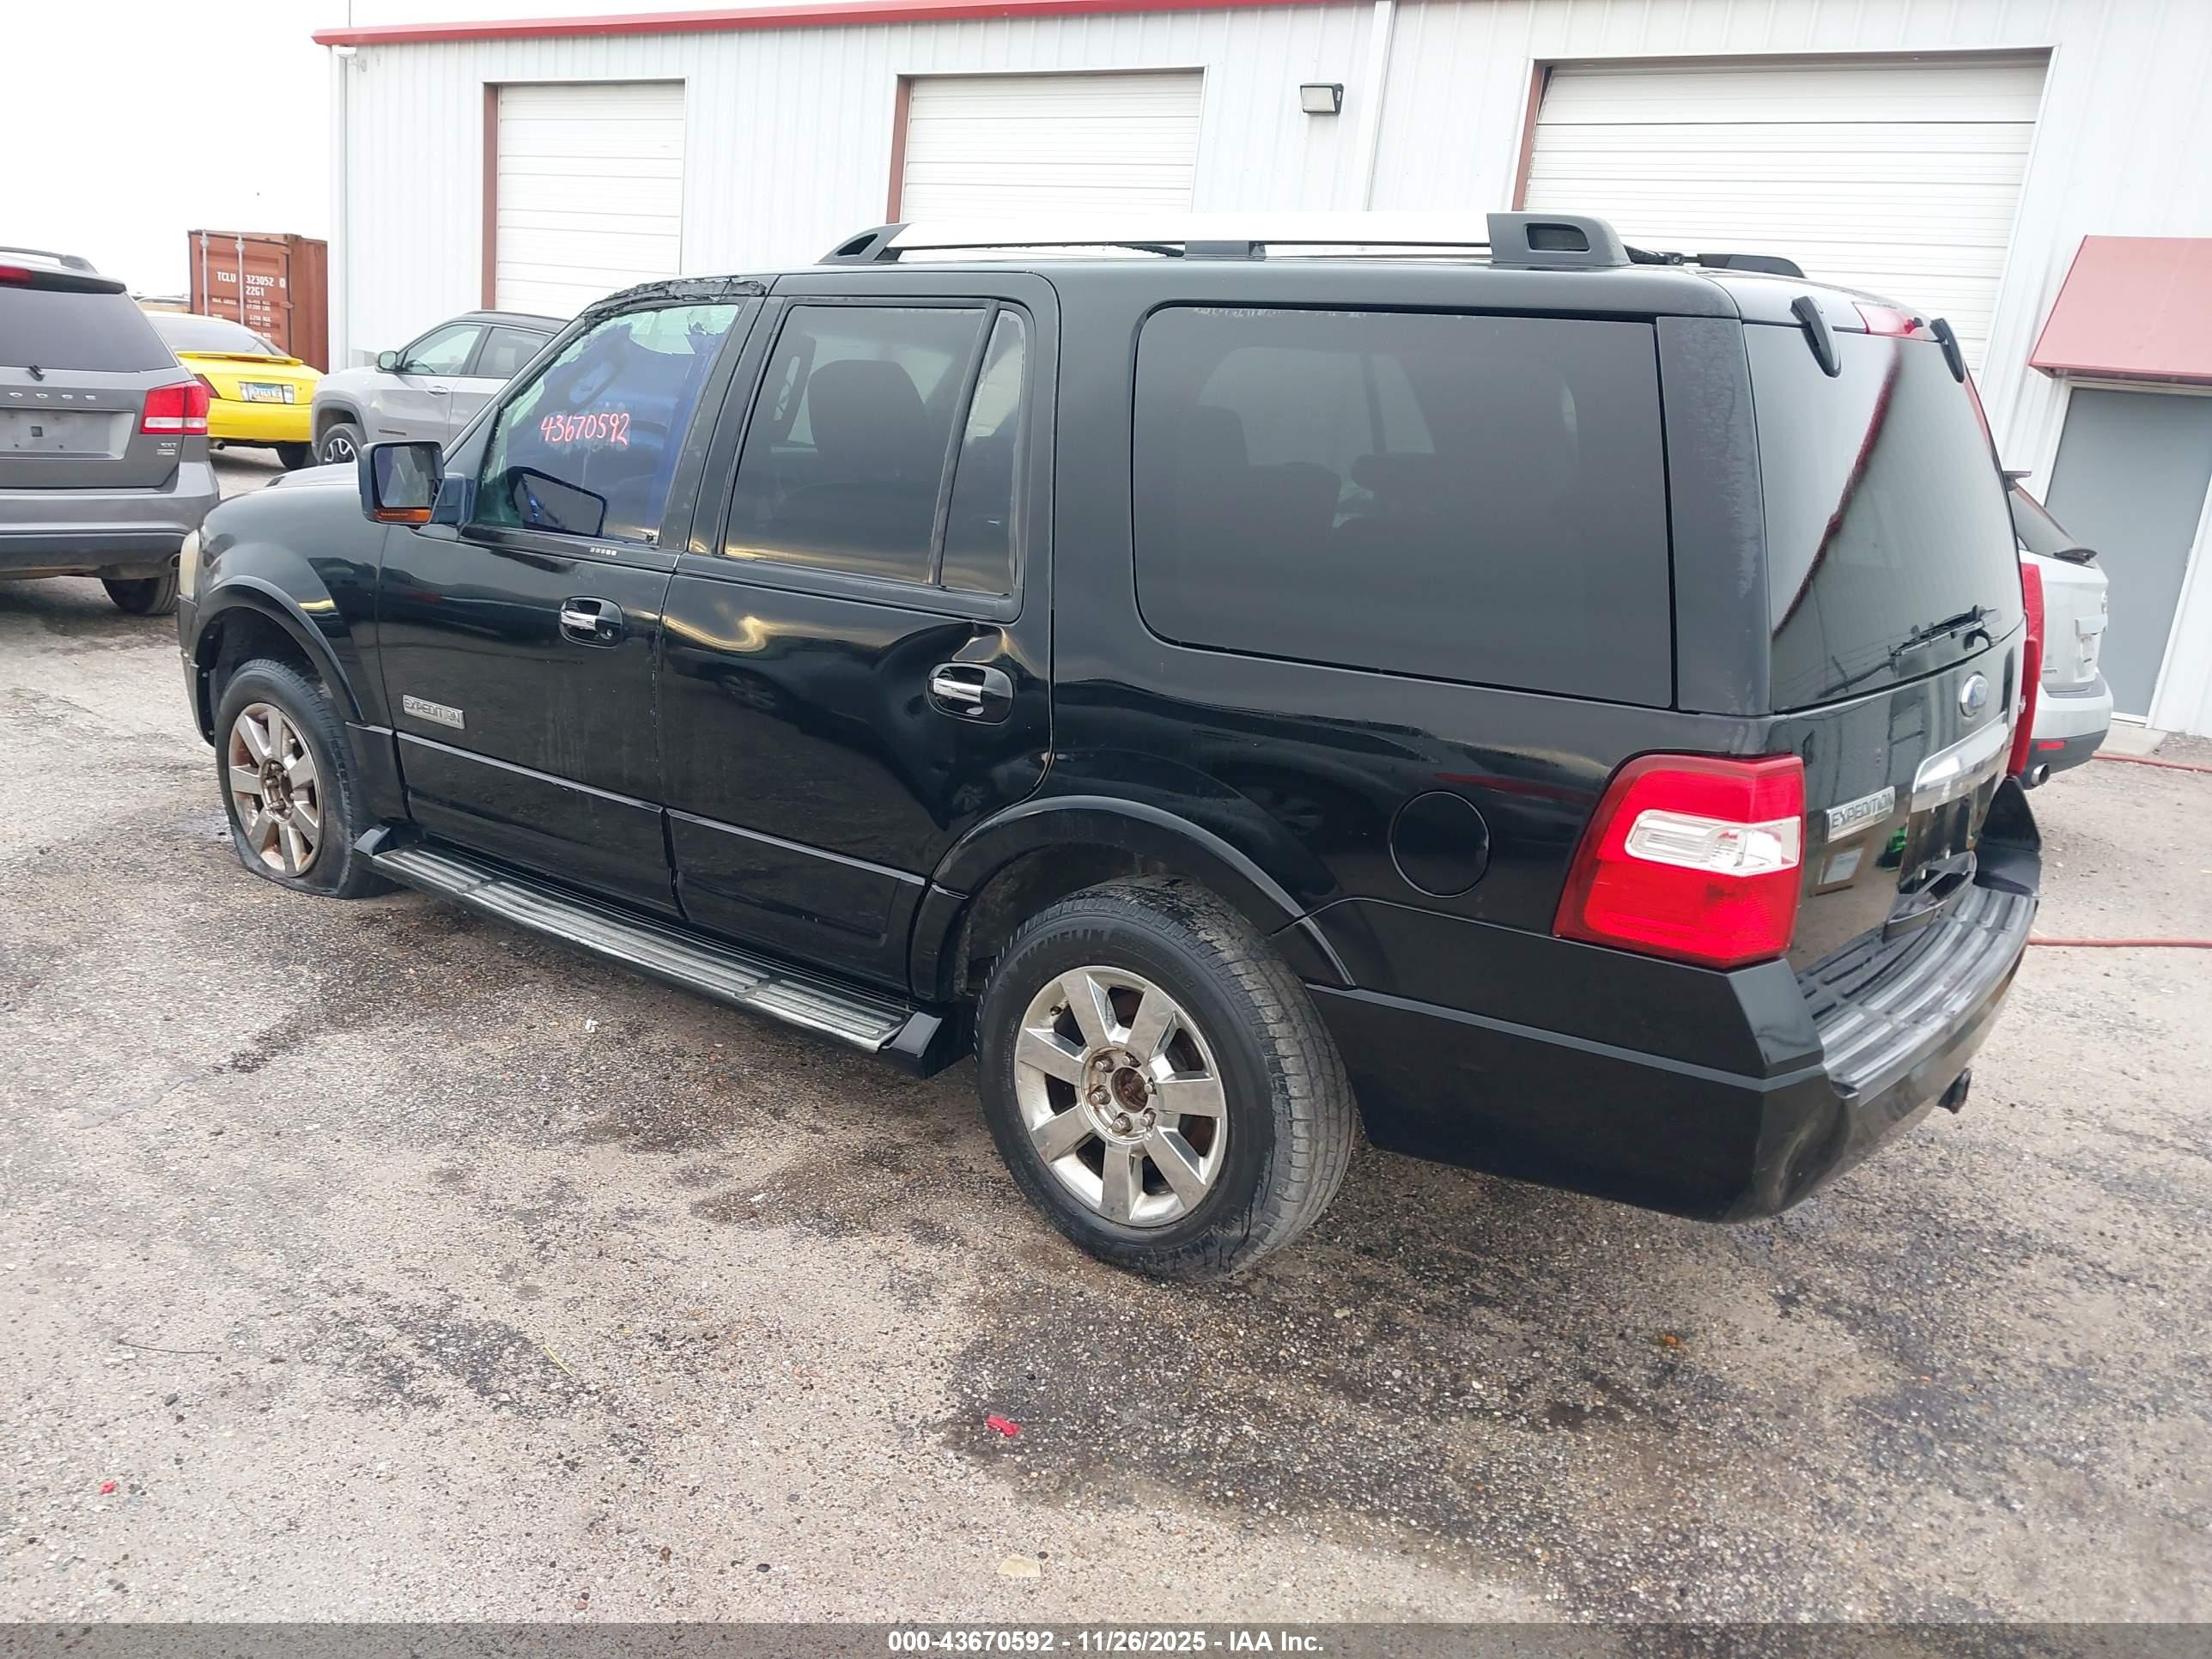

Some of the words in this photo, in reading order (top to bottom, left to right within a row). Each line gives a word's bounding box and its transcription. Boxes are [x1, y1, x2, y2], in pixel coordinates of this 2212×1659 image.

[216, 271, 237, 283] TCLU
[246, 275, 274, 287] 323052
[540, 412, 631, 447] 43670592
[404, 697, 461, 724] EXPEDITION
[1832, 793, 1894, 829] EXPEDITION
[1016, 928, 1110, 968] MICHELIN
